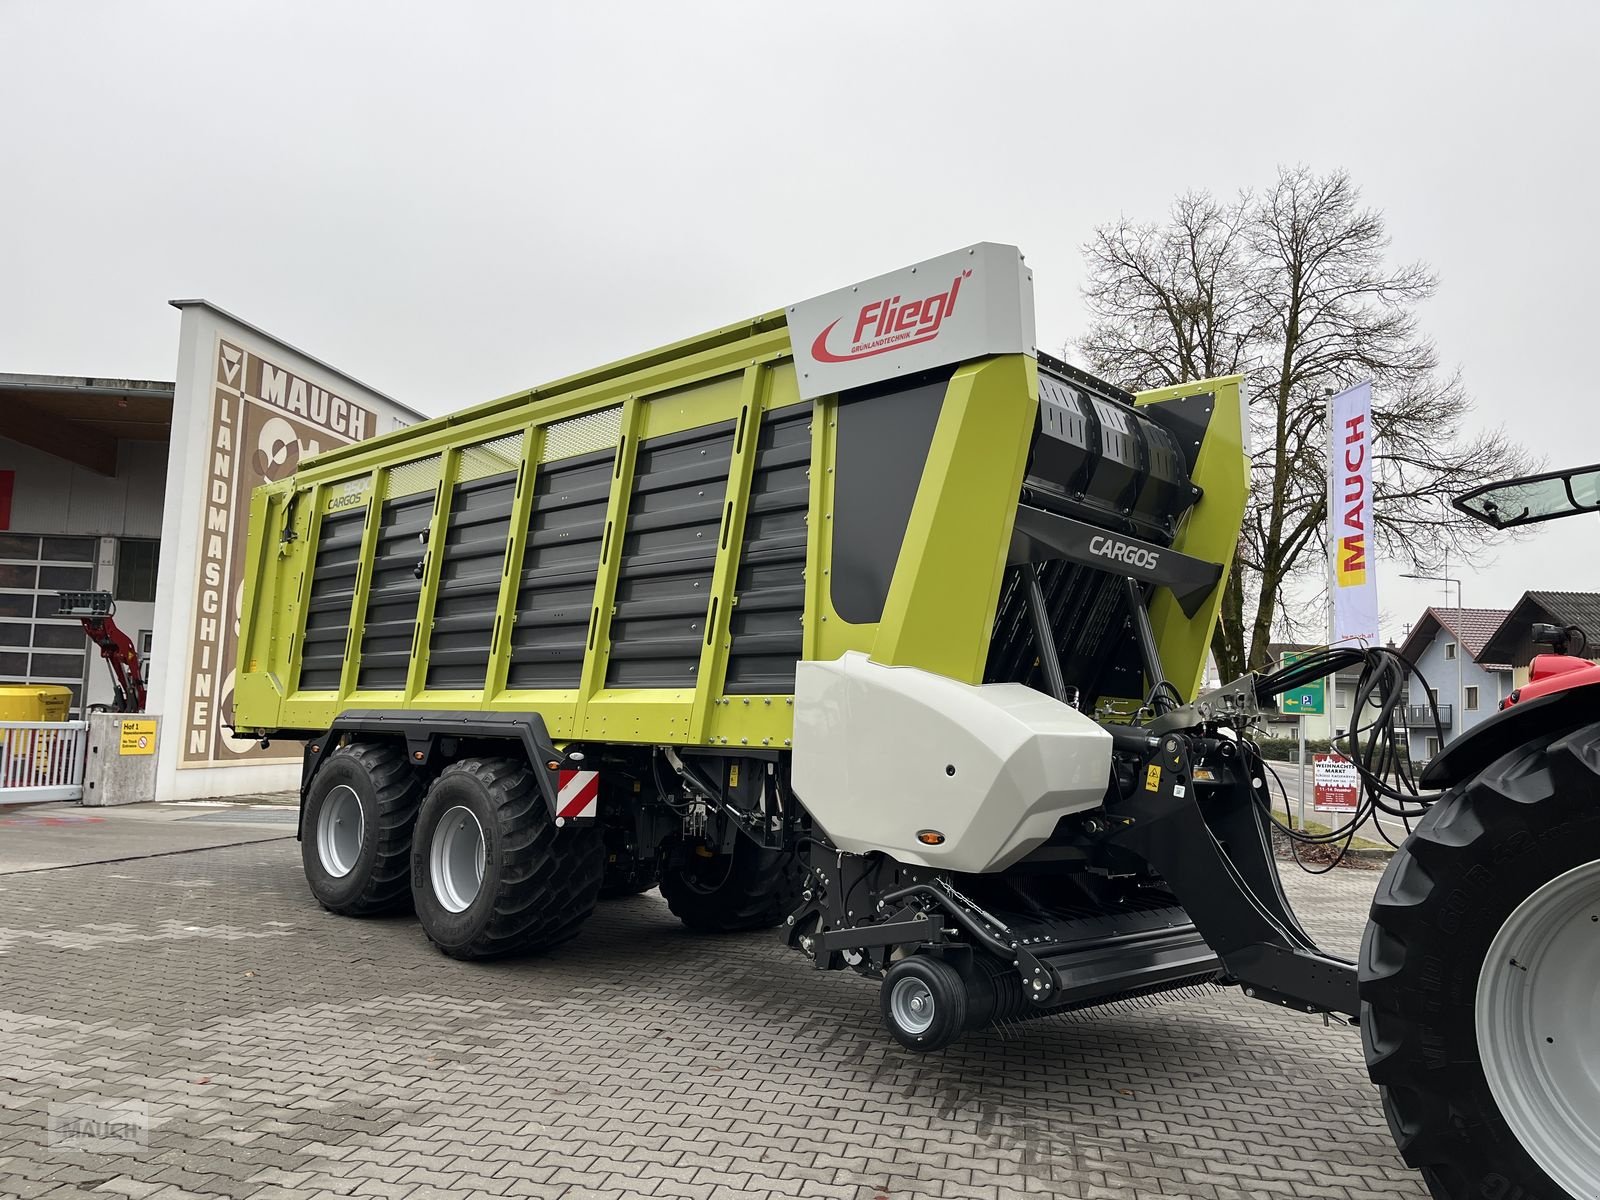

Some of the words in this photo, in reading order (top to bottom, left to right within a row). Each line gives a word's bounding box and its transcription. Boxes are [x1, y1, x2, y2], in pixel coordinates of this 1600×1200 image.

[850, 332, 911, 353] GRÜNLANDTECHNIK
[852, 276, 963, 344] Fliegl
[260, 361, 367, 441] MAUCH
[328, 492, 362, 510] CARGOS
[1343, 414, 1366, 572] MAUCH
[189, 398, 232, 754] LANDMASCHINEN
[1089, 535, 1160, 570] CARGOS
